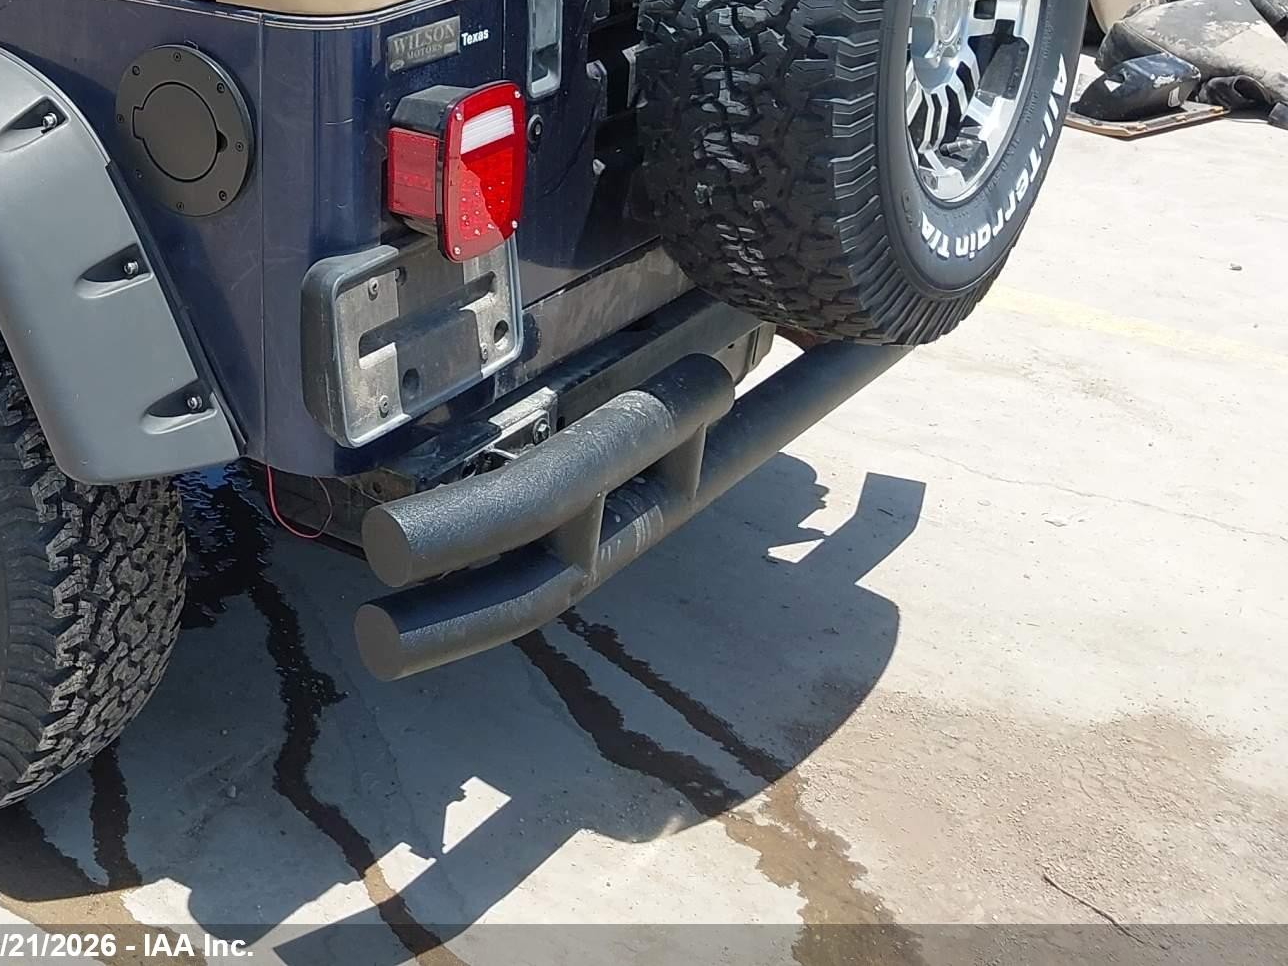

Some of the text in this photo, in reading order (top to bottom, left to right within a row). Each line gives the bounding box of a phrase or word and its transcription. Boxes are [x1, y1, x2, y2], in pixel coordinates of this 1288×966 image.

[393, 24, 456, 54] WILSON
[407, 43, 443, 59] MOTORS
[461, 29, 489, 46] Texas
[955, 54, 1067, 258] All-Terrain
[922, 210, 950, 258] T/A
